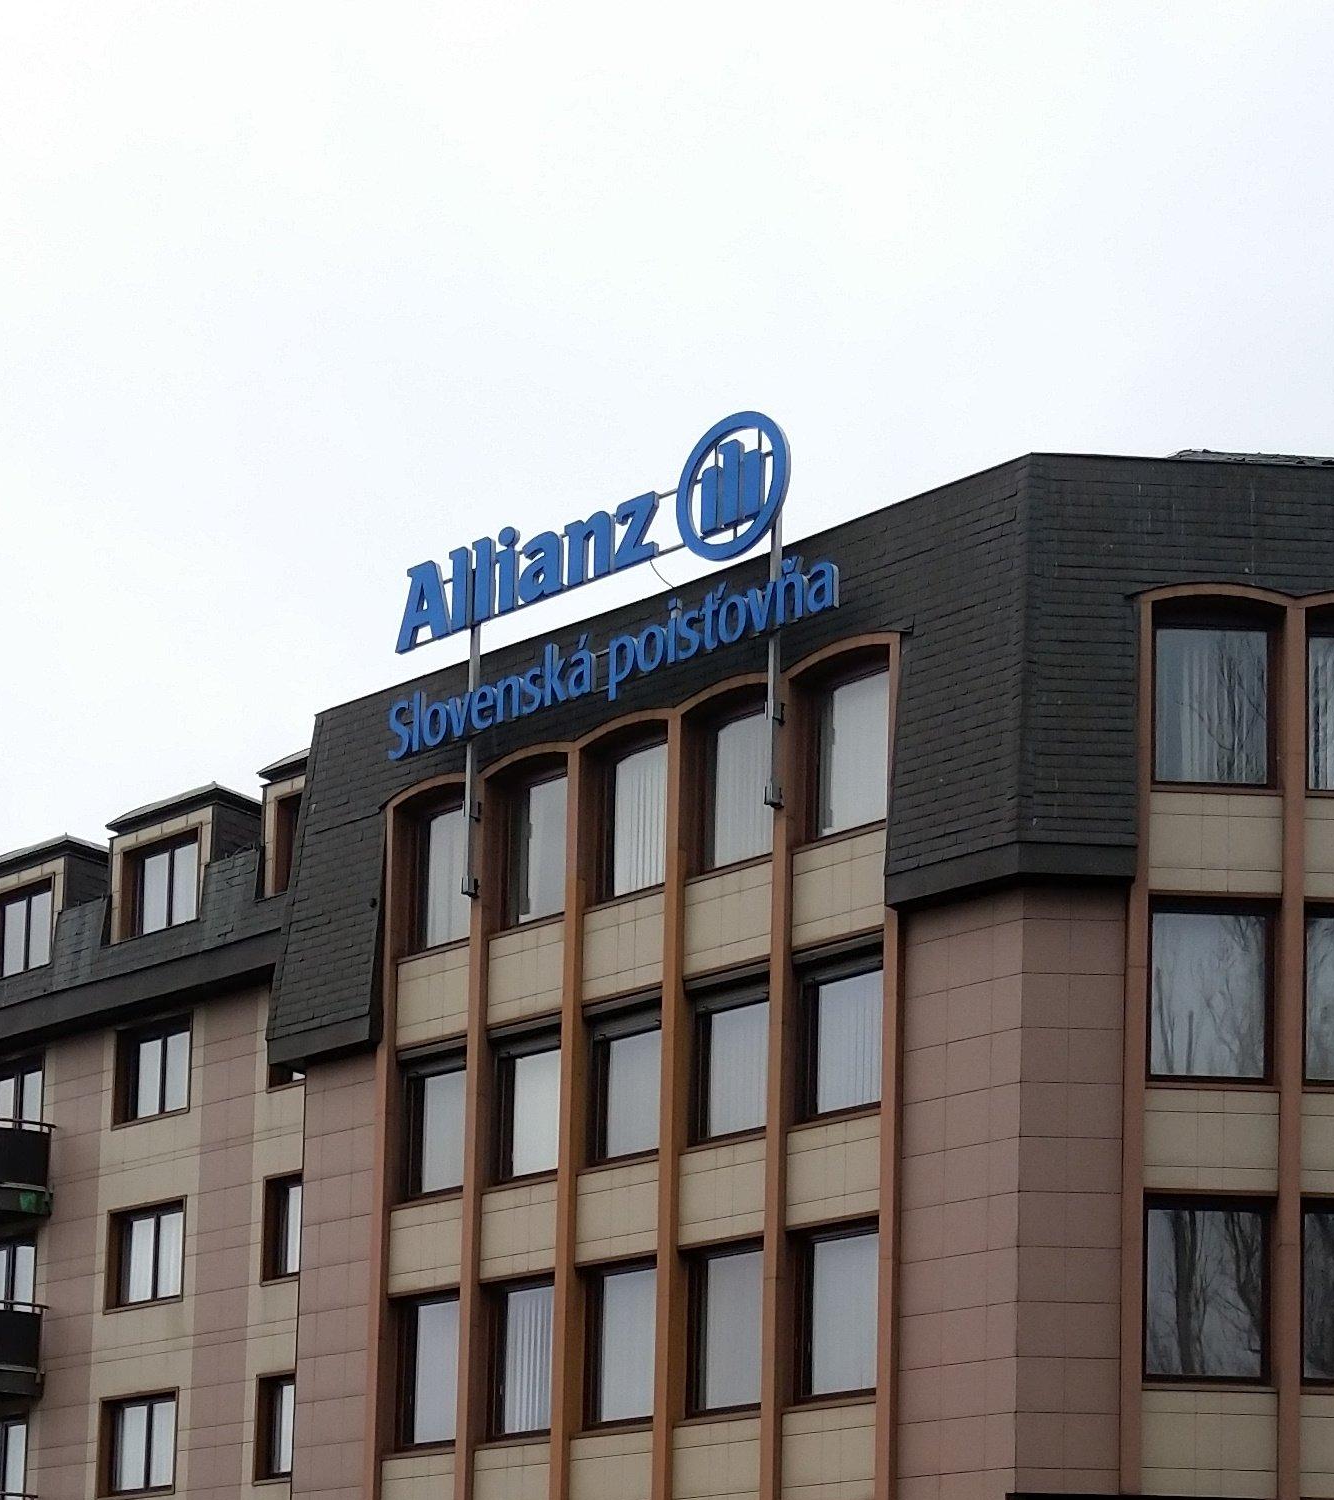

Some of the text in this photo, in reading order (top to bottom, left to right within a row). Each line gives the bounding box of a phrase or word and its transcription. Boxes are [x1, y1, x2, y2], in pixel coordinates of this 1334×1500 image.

[387, 555, 840, 761] Slovenská poisťovňa
[395, 491, 660, 654] Allianz
